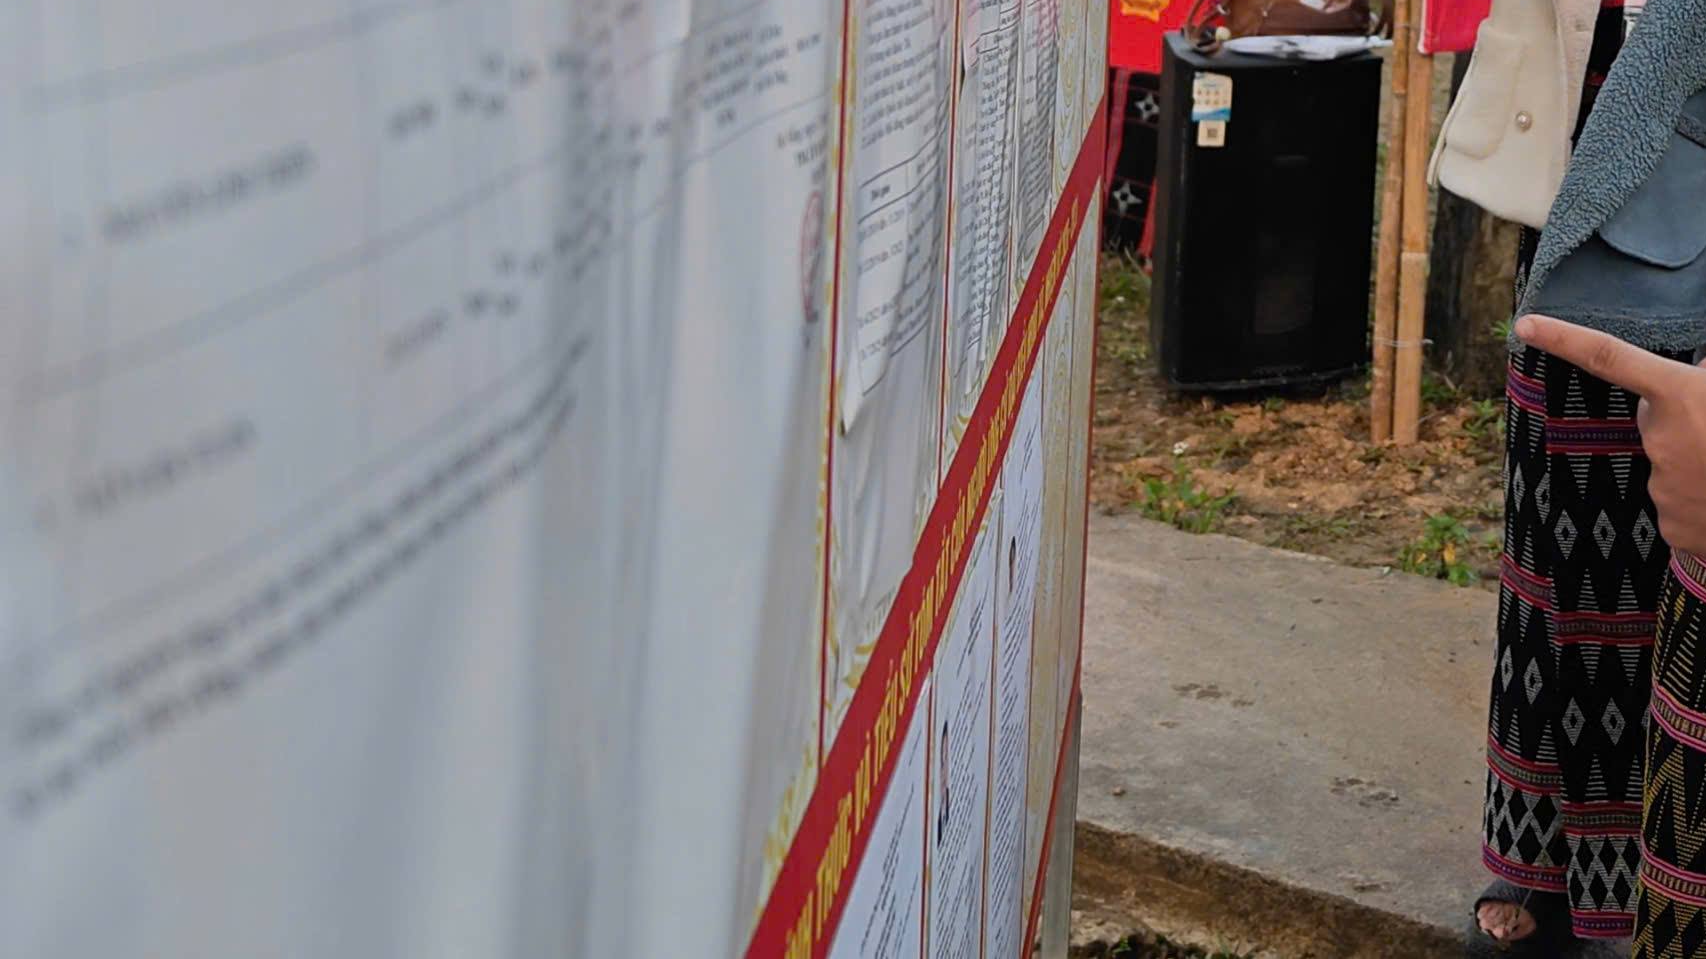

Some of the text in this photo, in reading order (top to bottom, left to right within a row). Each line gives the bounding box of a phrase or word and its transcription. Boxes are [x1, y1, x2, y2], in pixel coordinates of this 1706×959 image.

[855, 730, 871, 836] VÀ
[874, 659, 899, 786] TIỂU
[935, 524, 951, 617] TẮT
